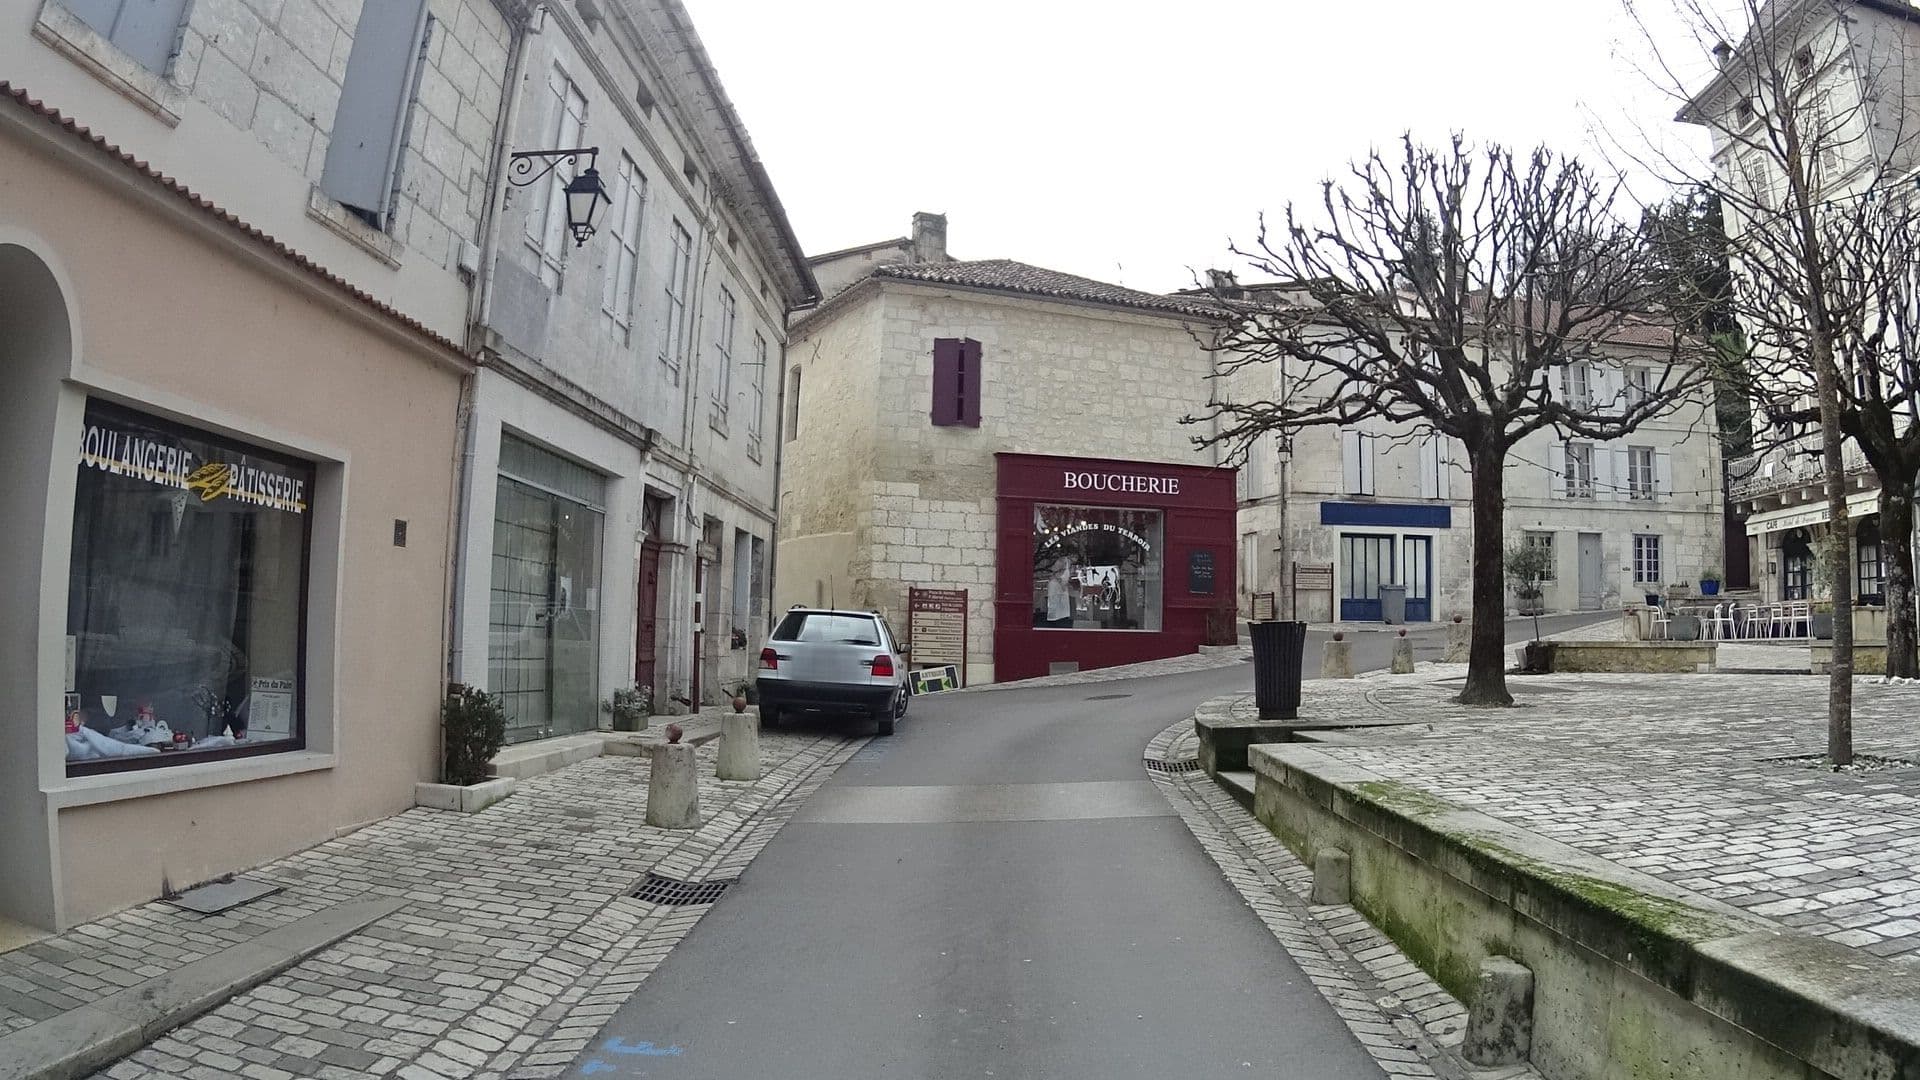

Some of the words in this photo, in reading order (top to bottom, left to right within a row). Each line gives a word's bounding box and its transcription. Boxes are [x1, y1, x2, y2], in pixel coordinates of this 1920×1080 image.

[78, 424, 192, 490] BOULANGERIE
[228, 454, 304, 513] PÂTISSERIE
[1063, 471, 1180, 495] BOUCHERIE
[1044, 535, 1060, 548] LES
[1061, 523, 1099, 538] VIANDES
[1103, 524, 1115, 532] DU
[1118, 527, 1151, 552] TERROIR
[258, 679, 269, 688] Prix
[271, 680, 278, 688] du
